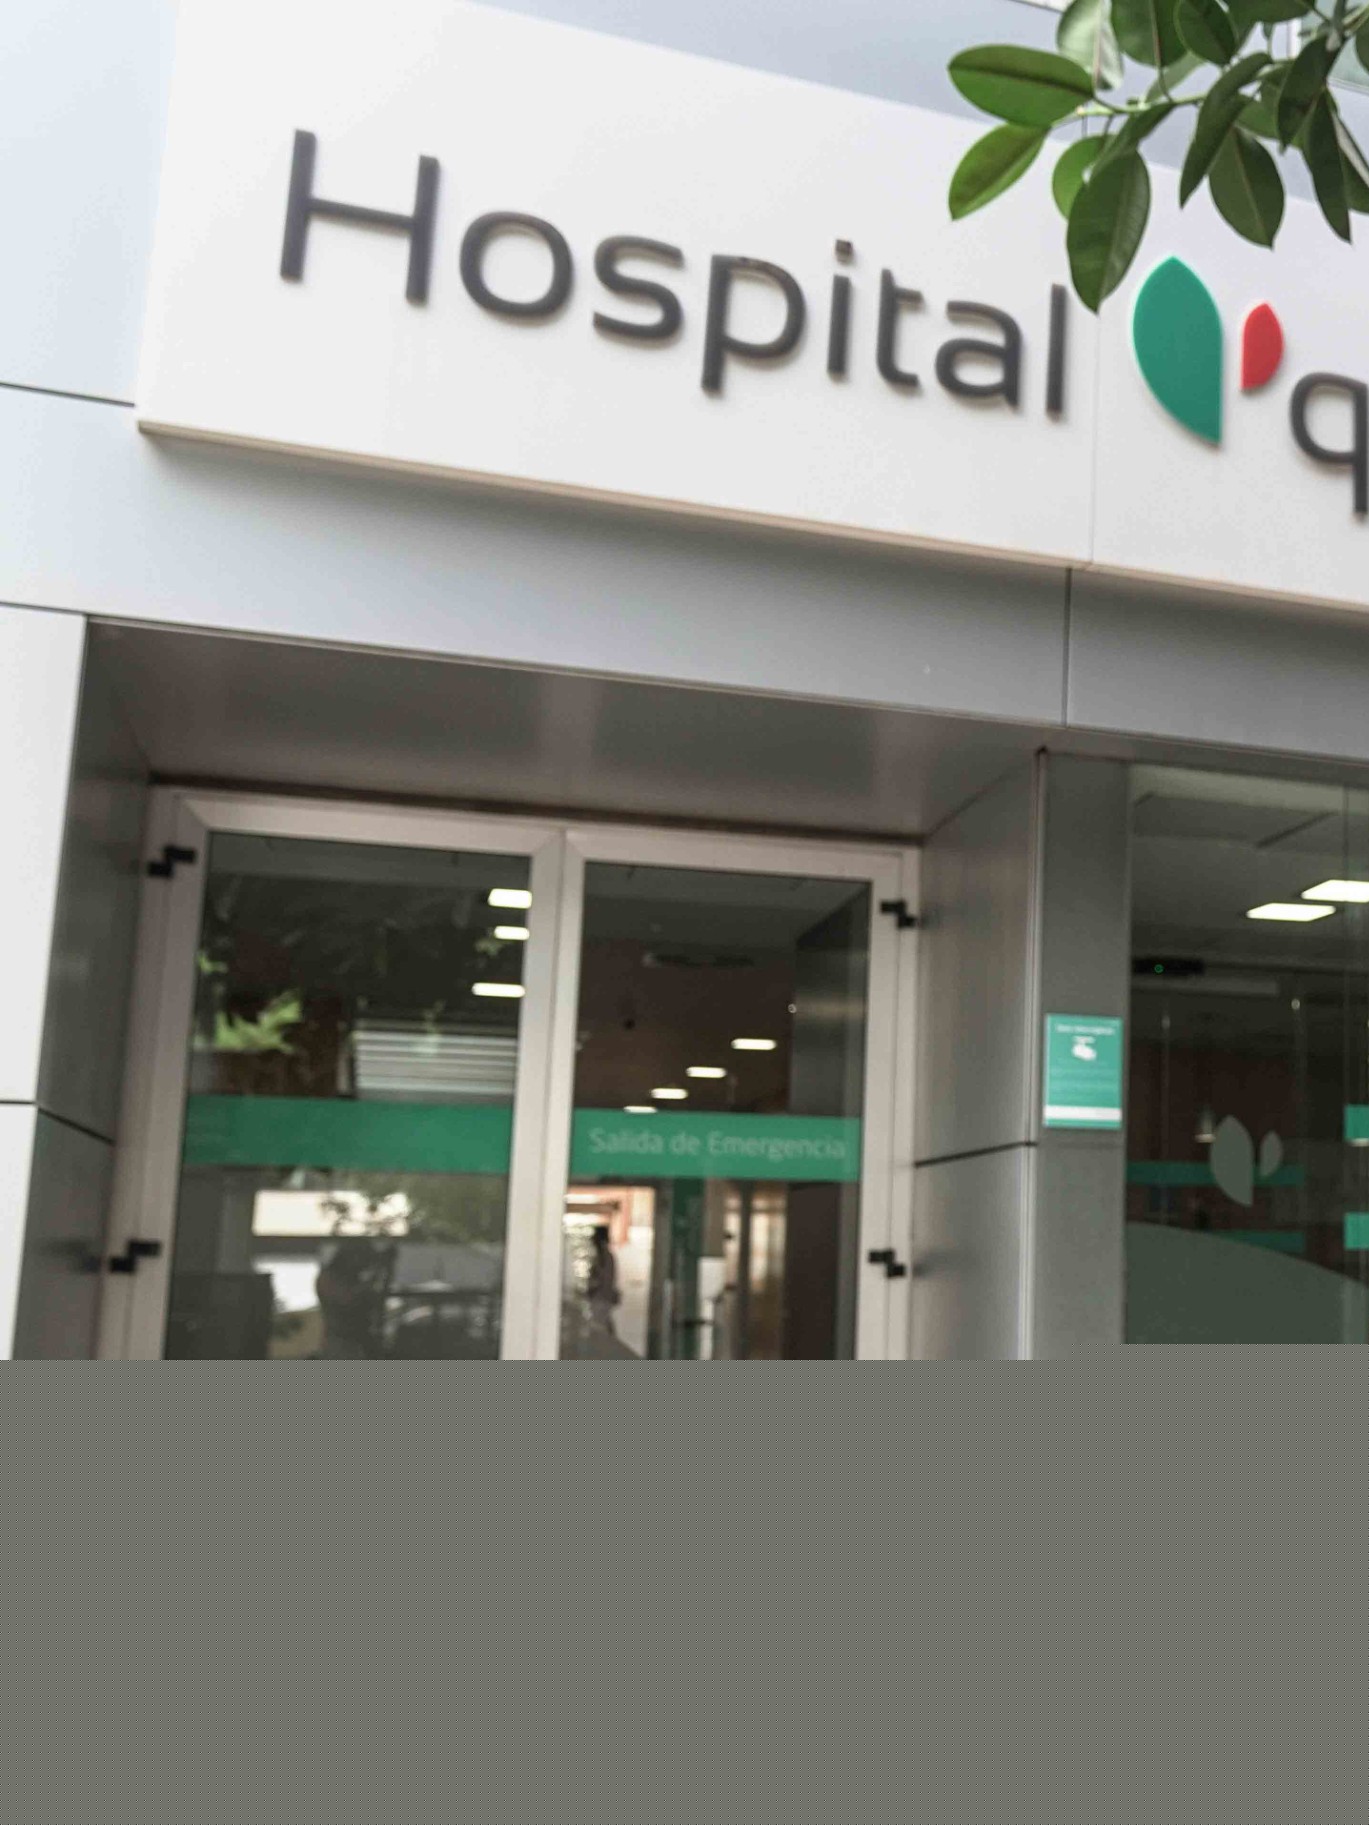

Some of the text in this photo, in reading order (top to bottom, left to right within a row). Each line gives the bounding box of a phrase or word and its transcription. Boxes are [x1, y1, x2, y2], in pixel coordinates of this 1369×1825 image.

[280, 129, 1068, 418] Hospital
[588, 1127, 846, 1163] Salida de Emergencia
